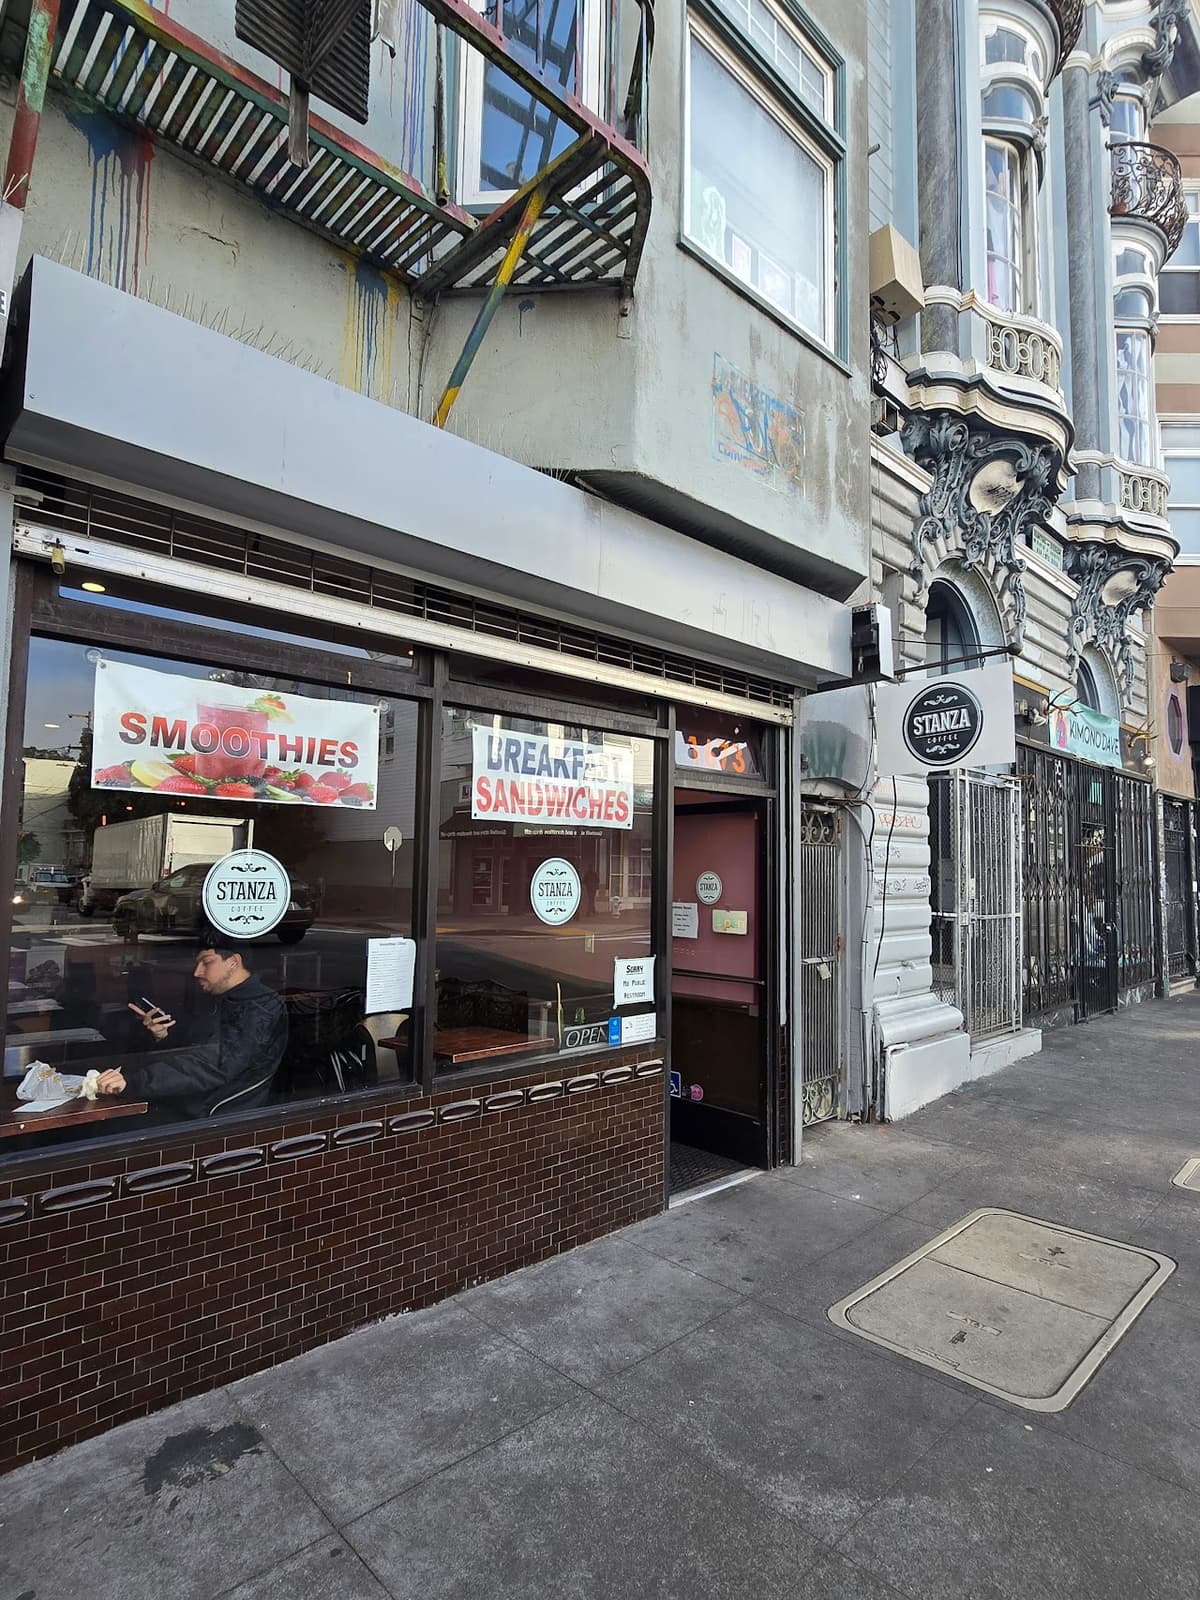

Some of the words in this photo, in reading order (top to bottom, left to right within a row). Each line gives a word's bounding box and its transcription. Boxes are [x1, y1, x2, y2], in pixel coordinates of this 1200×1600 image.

[913, 708, 971, 735] STANZA
[119, 711, 359, 769] SMOOTHIES
[927, 733, 958, 744] COFFEE
[1069, 719, 1101, 749] KIMONO
[1102, 732, 1119, 756] DAVE
[476, 775, 629, 822] SANDWICHES
[216, 881, 276, 900] STANZA
[538, 882, 573, 897] STANZA
[231, 905, 263, 913] COFFEE
[566, 1026, 607, 1047] OPEN
